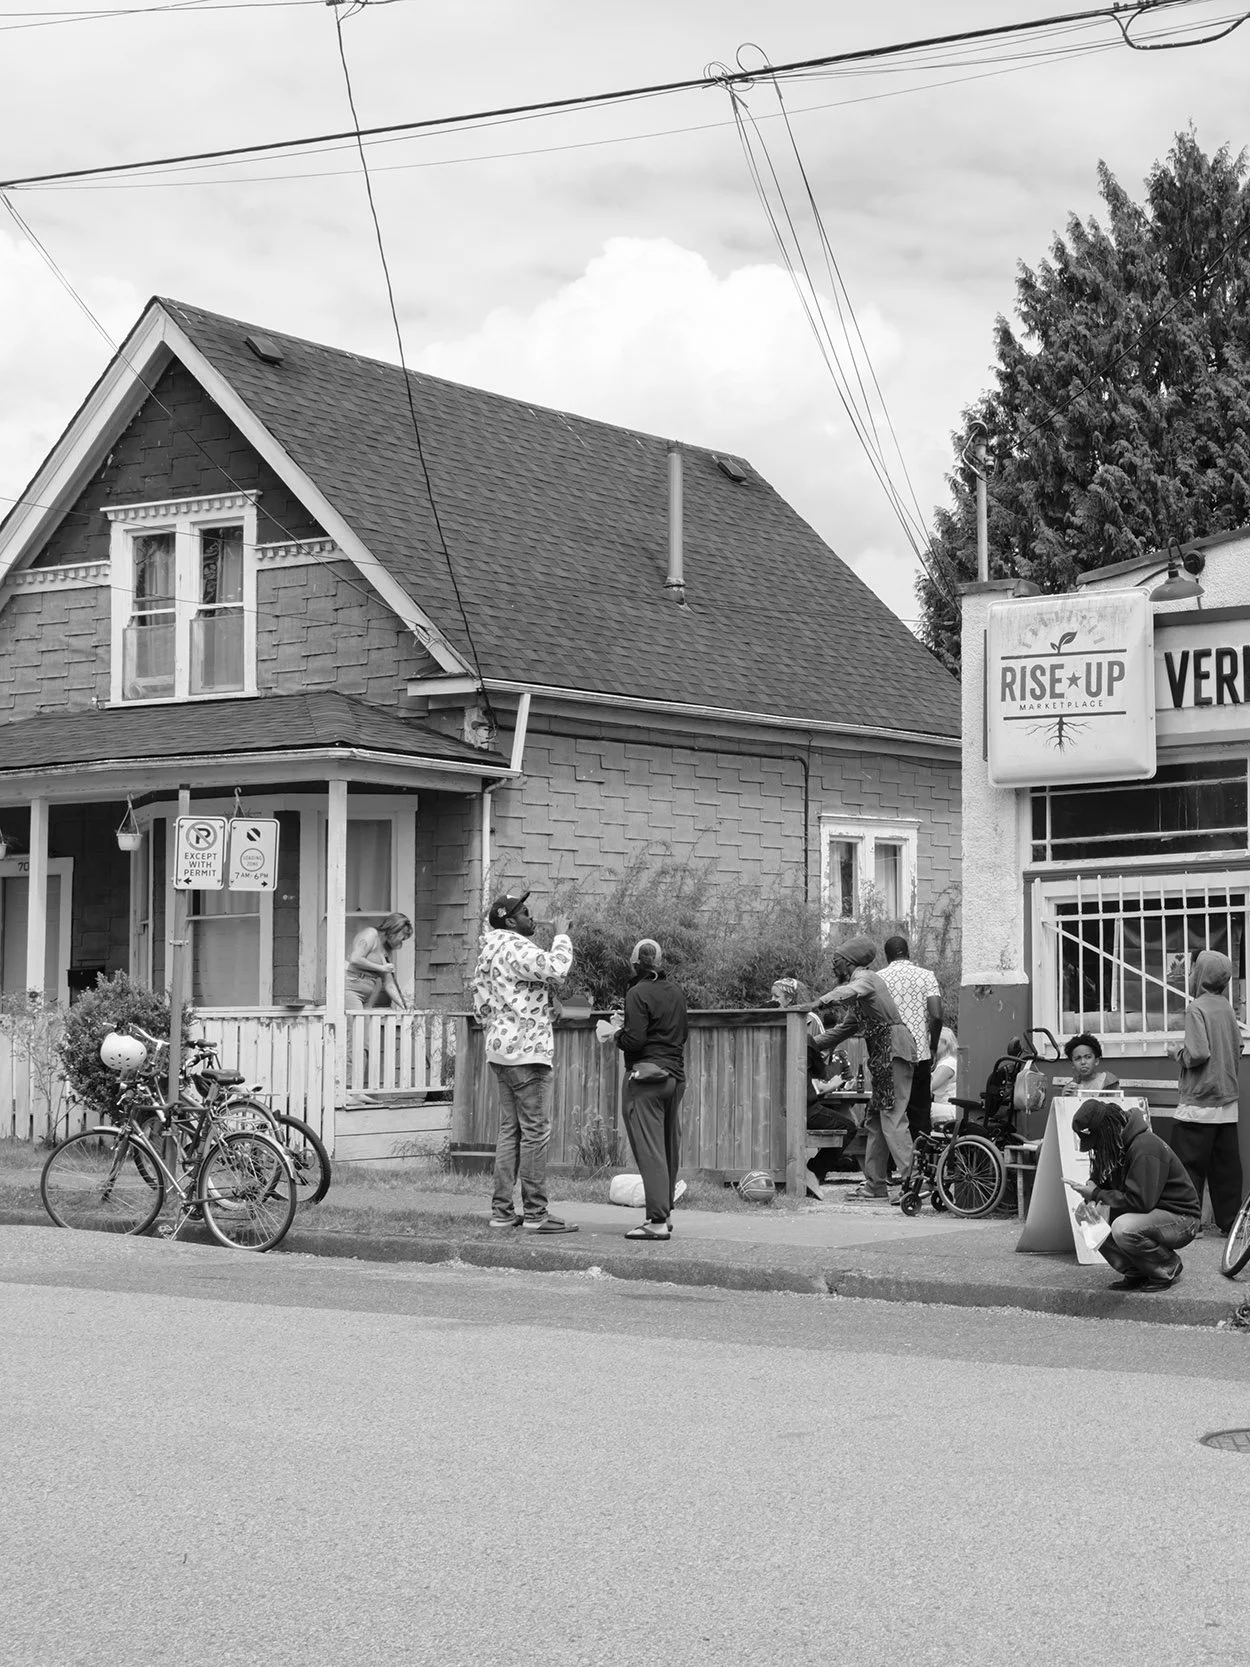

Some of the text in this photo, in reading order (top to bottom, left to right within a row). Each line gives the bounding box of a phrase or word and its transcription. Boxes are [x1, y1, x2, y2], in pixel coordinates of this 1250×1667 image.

[1019, 700, 1103, 711] MARKETPLACE
[184, 852, 217, 860] EXCEPT
[183, 868, 217, 877] PERMIT
